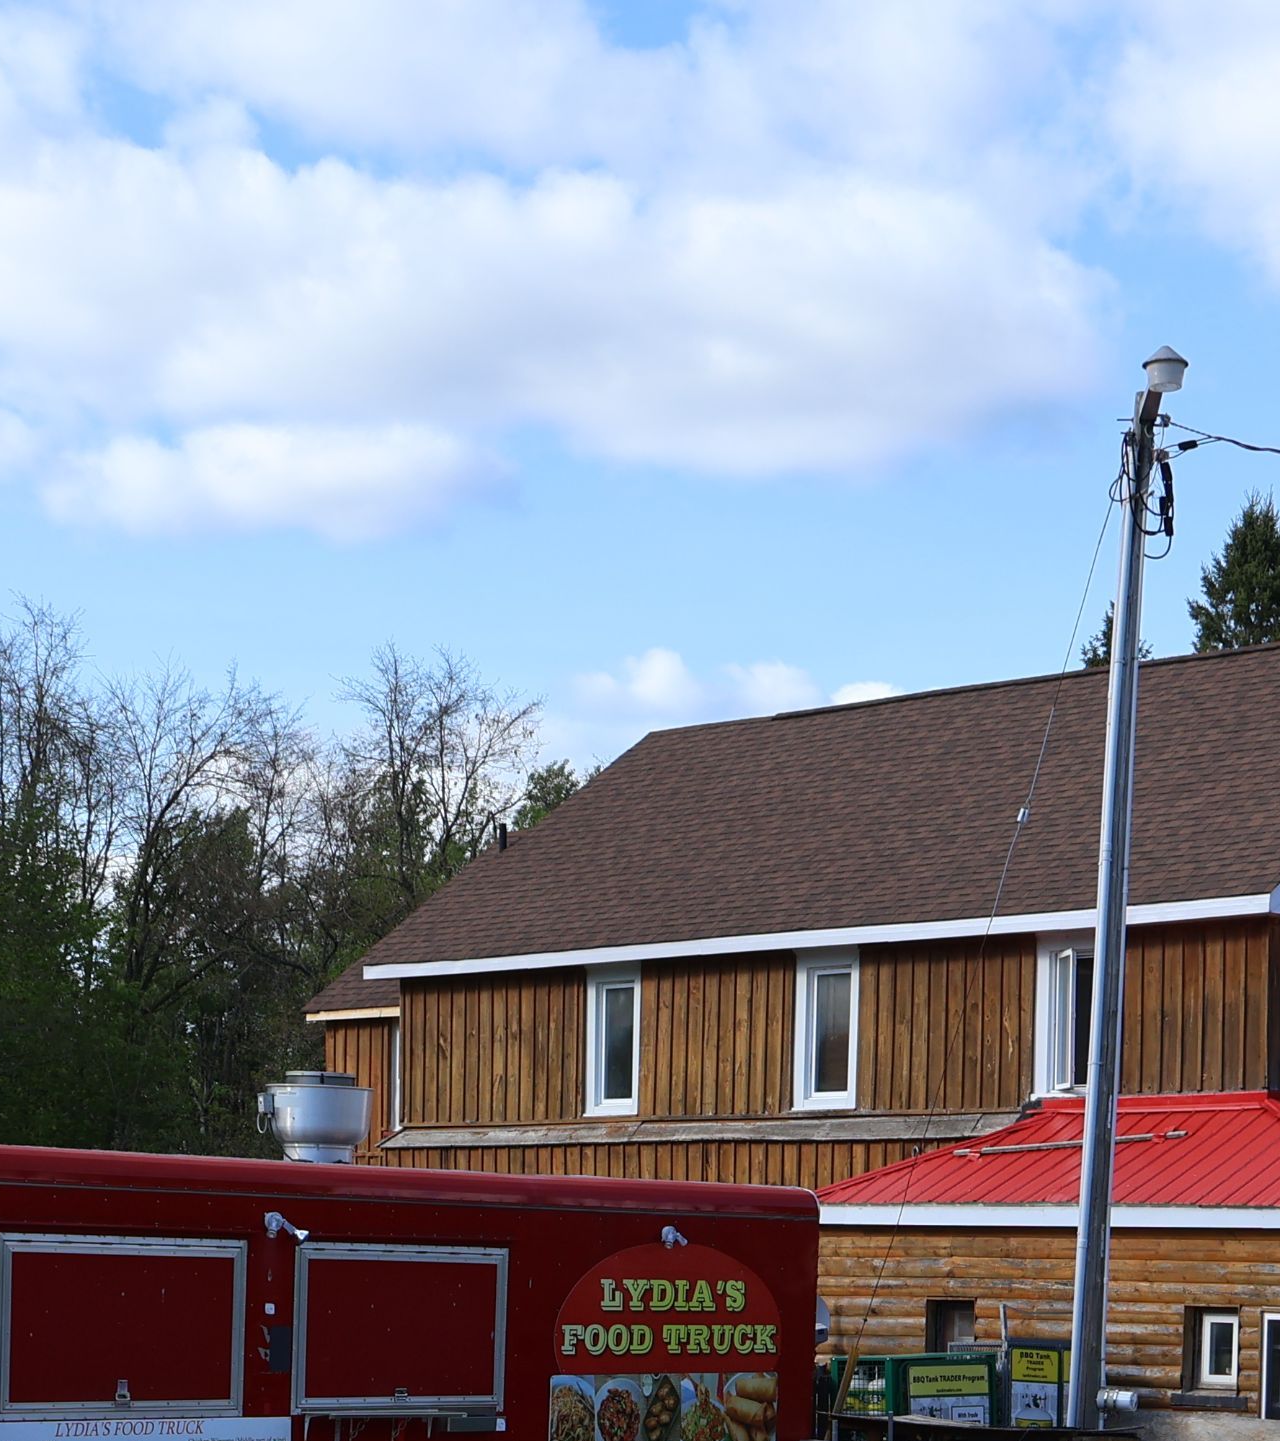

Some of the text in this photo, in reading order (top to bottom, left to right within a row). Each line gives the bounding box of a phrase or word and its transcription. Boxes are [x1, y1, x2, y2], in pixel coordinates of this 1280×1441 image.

[600, 1278, 746, 1312] LYDIA'S
[561, 1324, 778, 1355] FOOD TRUCK
[913, 1375, 925, 1383] BBQ
[926, 1375, 939, 1383] Tank
[962, 1374, 985, 1383] Program
[55, 1420, 204, 1437] LYDIA'S FOOD TRUCK
